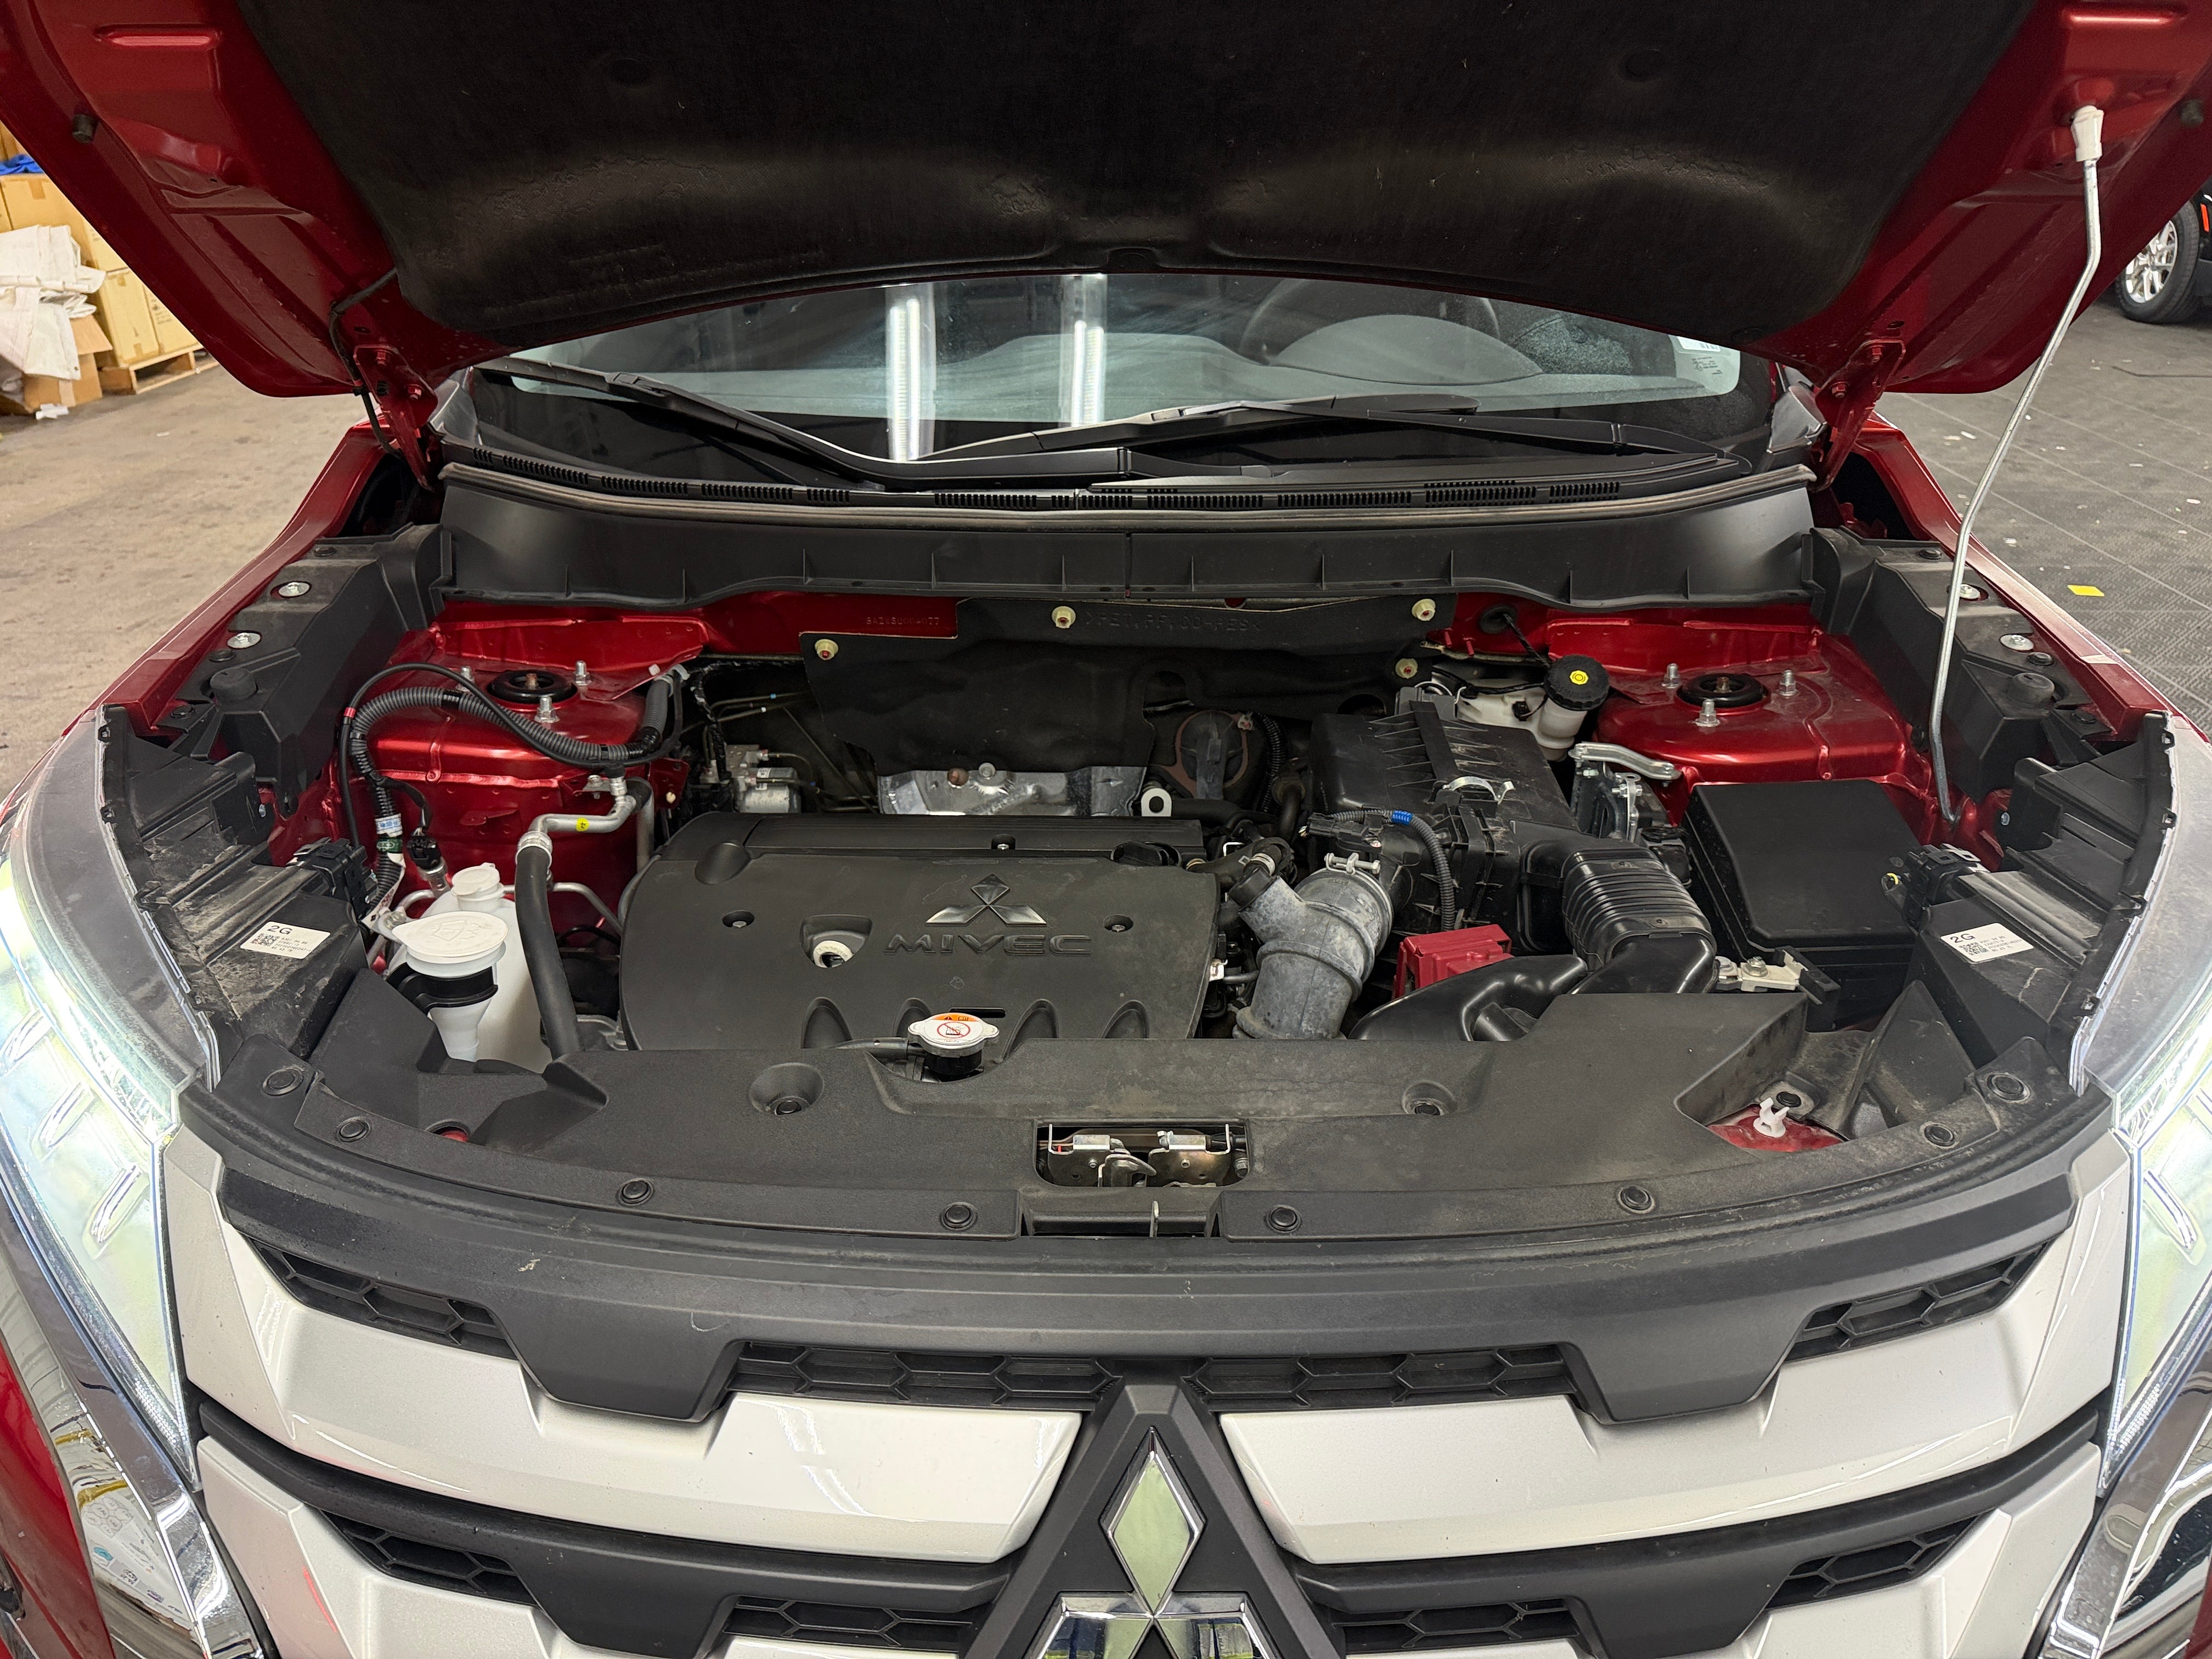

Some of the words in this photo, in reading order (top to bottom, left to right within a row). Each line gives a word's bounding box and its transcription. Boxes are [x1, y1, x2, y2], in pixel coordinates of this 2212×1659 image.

[267, 926, 292, 935] 2G
[1950, 934, 1976, 943] 2G
[884, 934, 1092, 955] MIVEC
